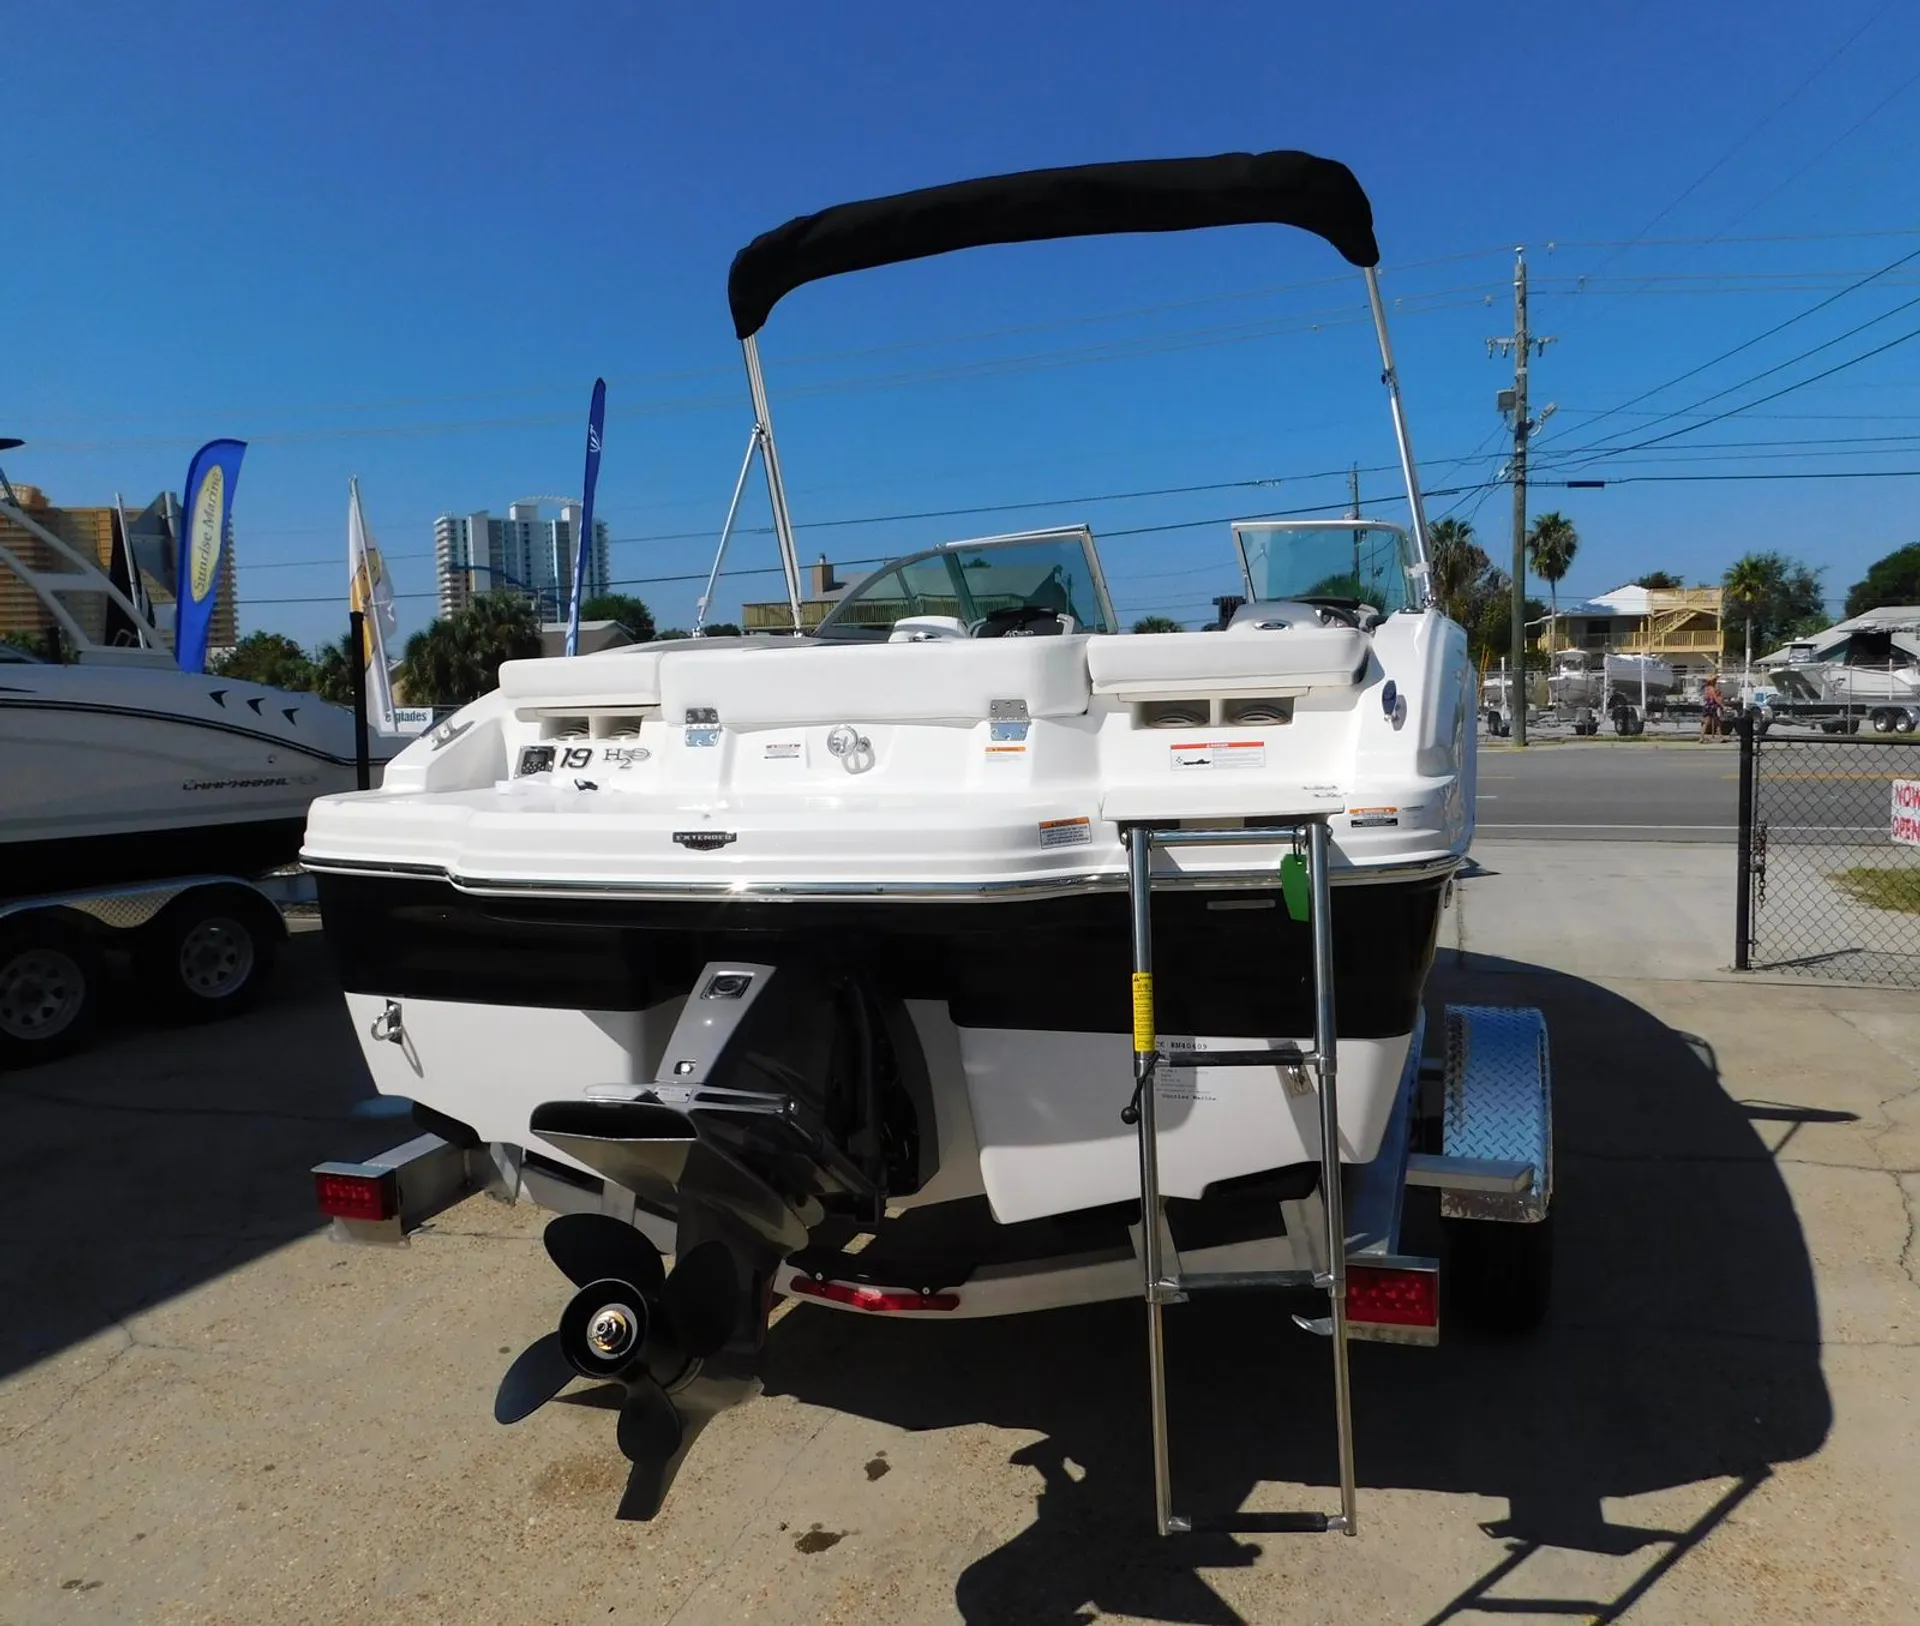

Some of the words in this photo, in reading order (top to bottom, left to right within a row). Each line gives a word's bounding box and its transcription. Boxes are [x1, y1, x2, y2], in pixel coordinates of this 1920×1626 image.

[202, 472, 223, 531] Marine
[193, 531, 213, 590] Sunrise
[560, 747, 594, 769] 19
[1893, 815, 1920, 842] OPEN
